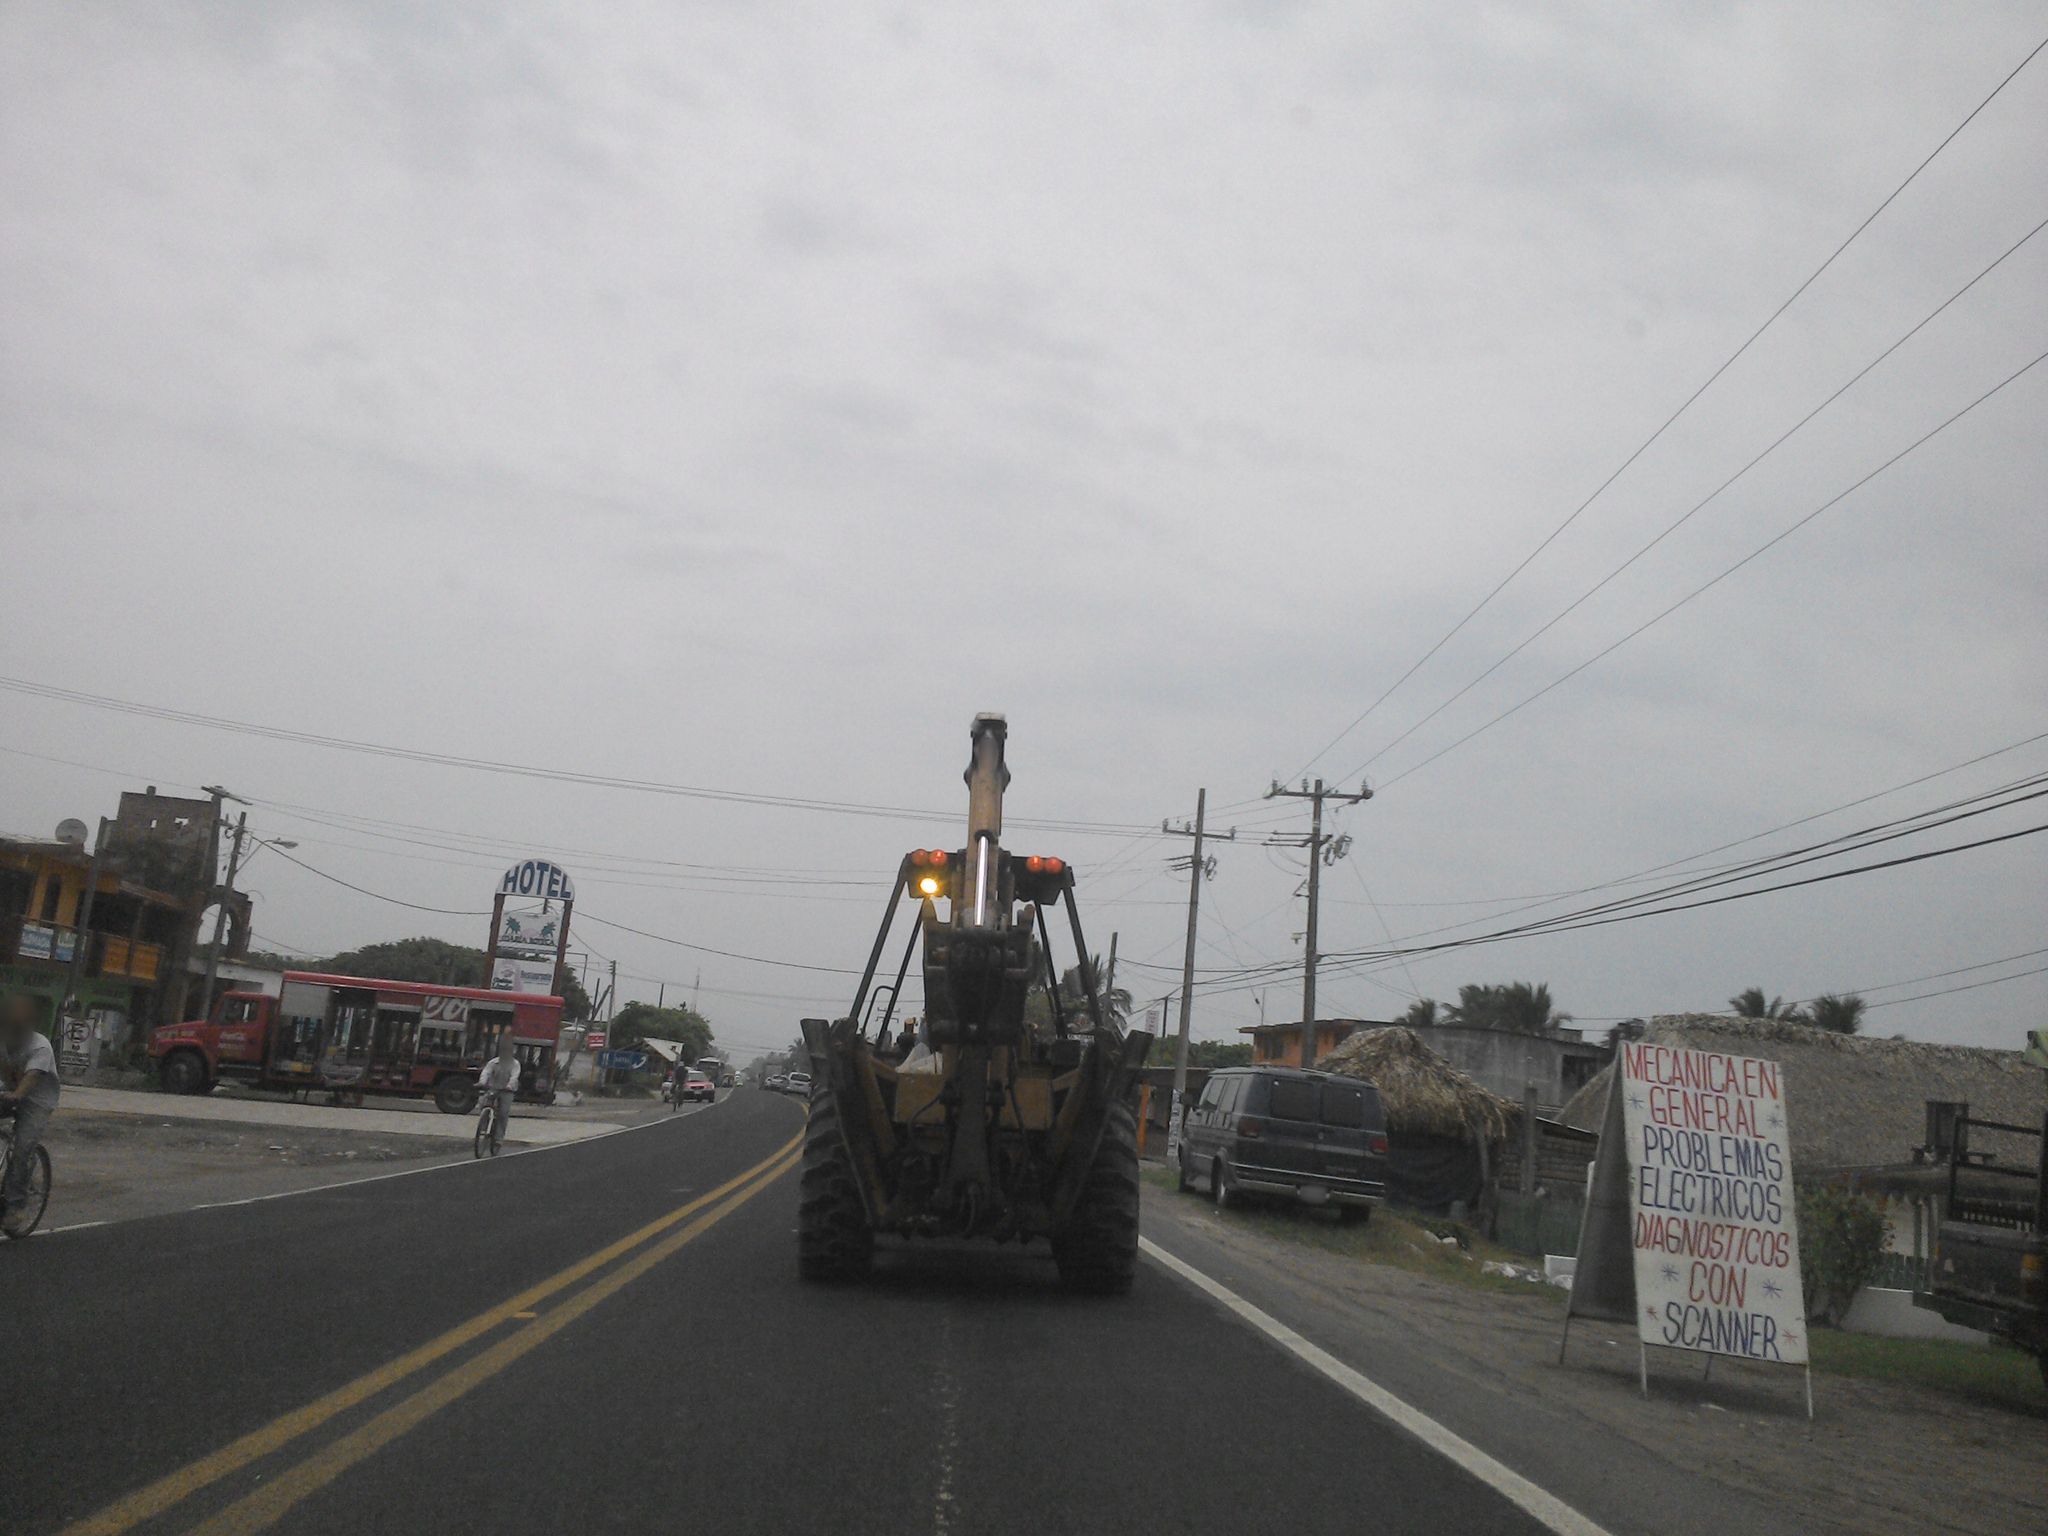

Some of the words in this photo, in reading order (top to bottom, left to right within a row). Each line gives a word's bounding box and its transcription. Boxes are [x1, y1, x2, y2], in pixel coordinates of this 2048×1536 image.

[503, 861, 571, 899] HOTEL
[1625, 1042, 1741, 1095] MECANICA
[1743, 1059, 1779, 1100] EN
[1649, 1086, 1766, 1140] GENERAL
[1643, 1125, 1783, 1182] PROBLEMAS
[1639, 1166, 1782, 1225] ELECTRICOS
[1634, 1212, 1790, 1268] DIAGNOSTICOS
[1689, 1261, 1747, 1309] CON
[1663, 1301, 1781, 1361] SCANNER
